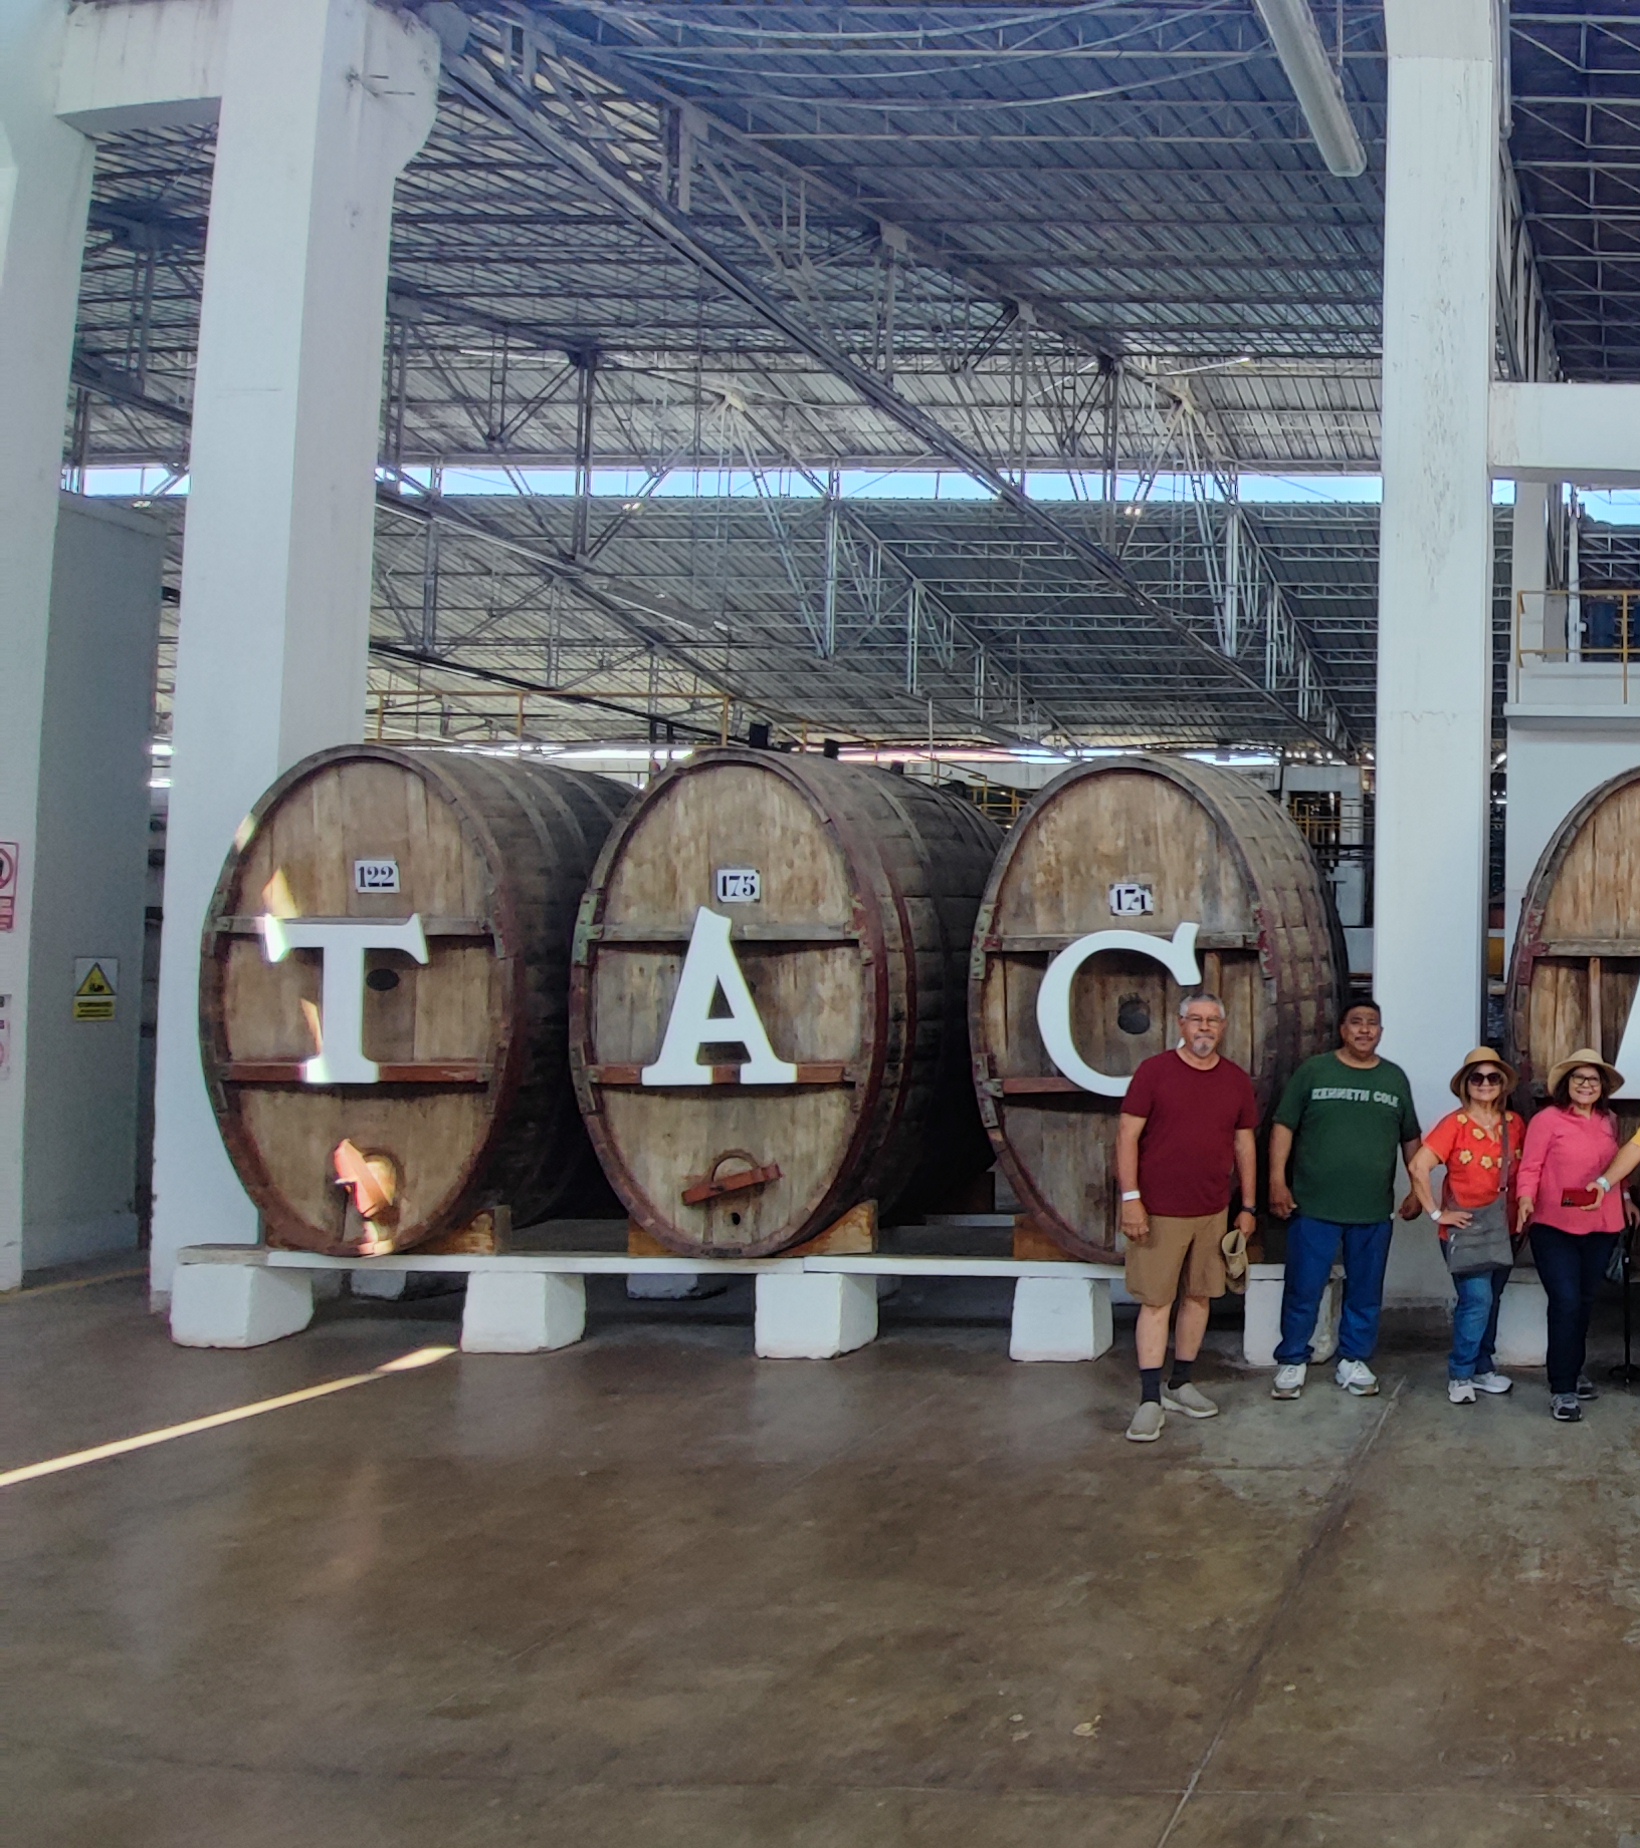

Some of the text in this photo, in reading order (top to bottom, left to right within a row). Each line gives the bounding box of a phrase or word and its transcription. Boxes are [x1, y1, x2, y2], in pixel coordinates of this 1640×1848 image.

[358, 866, 395, 888] 122
[721, 875, 756, 897] 175
[1311, 1087, 1399, 1108] KENNETH COLE
